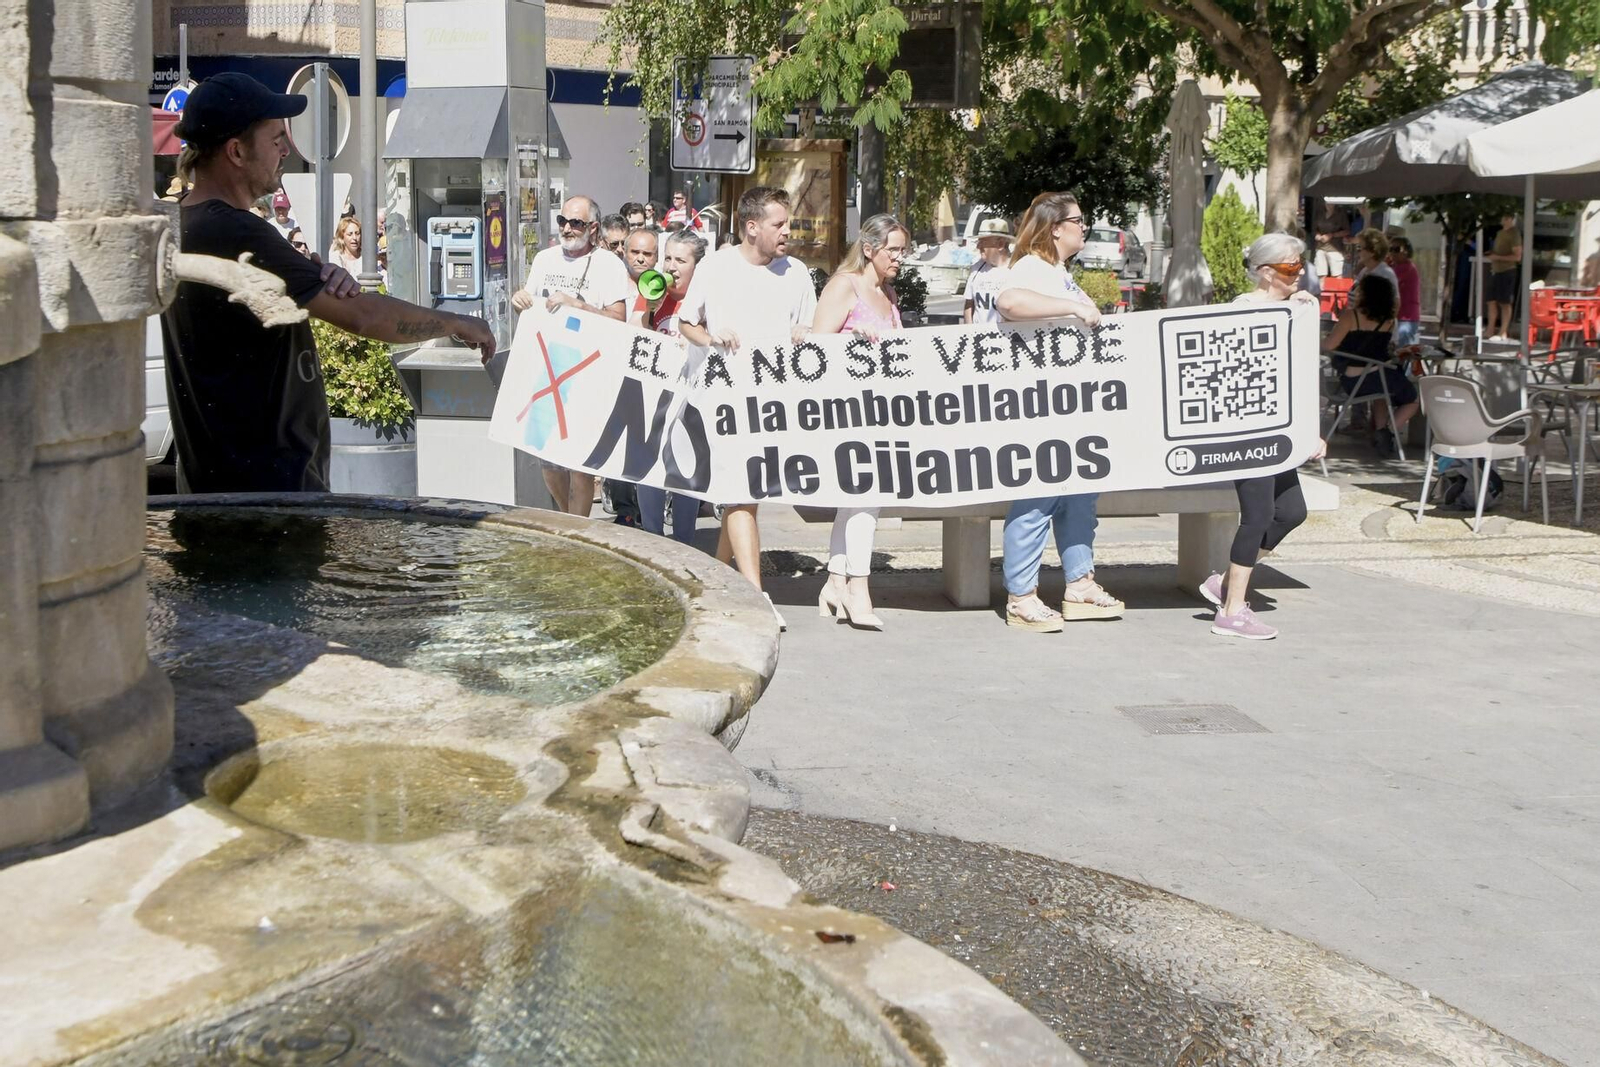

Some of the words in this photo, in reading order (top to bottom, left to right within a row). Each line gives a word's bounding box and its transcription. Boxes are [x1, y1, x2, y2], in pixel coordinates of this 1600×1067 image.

[628, 333, 669, 380] EL
[695, 352, 733, 389] A
[749, 340, 829, 386] NO
[845, 336, 914, 381] SE
[931, 322, 1127, 376] VENDE
[582, 376, 711, 494] NO
[715, 403, 738, 436] a
[746, 396, 788, 434] la
[797, 379, 1128, 432] embotelladora
[746, 446, 820, 500] de
[834, 435, 1111, 499] Cijancos
[1201, 450, 1242, 465] FIRMA
[1244, 442, 1278, 460] AQUÍ
